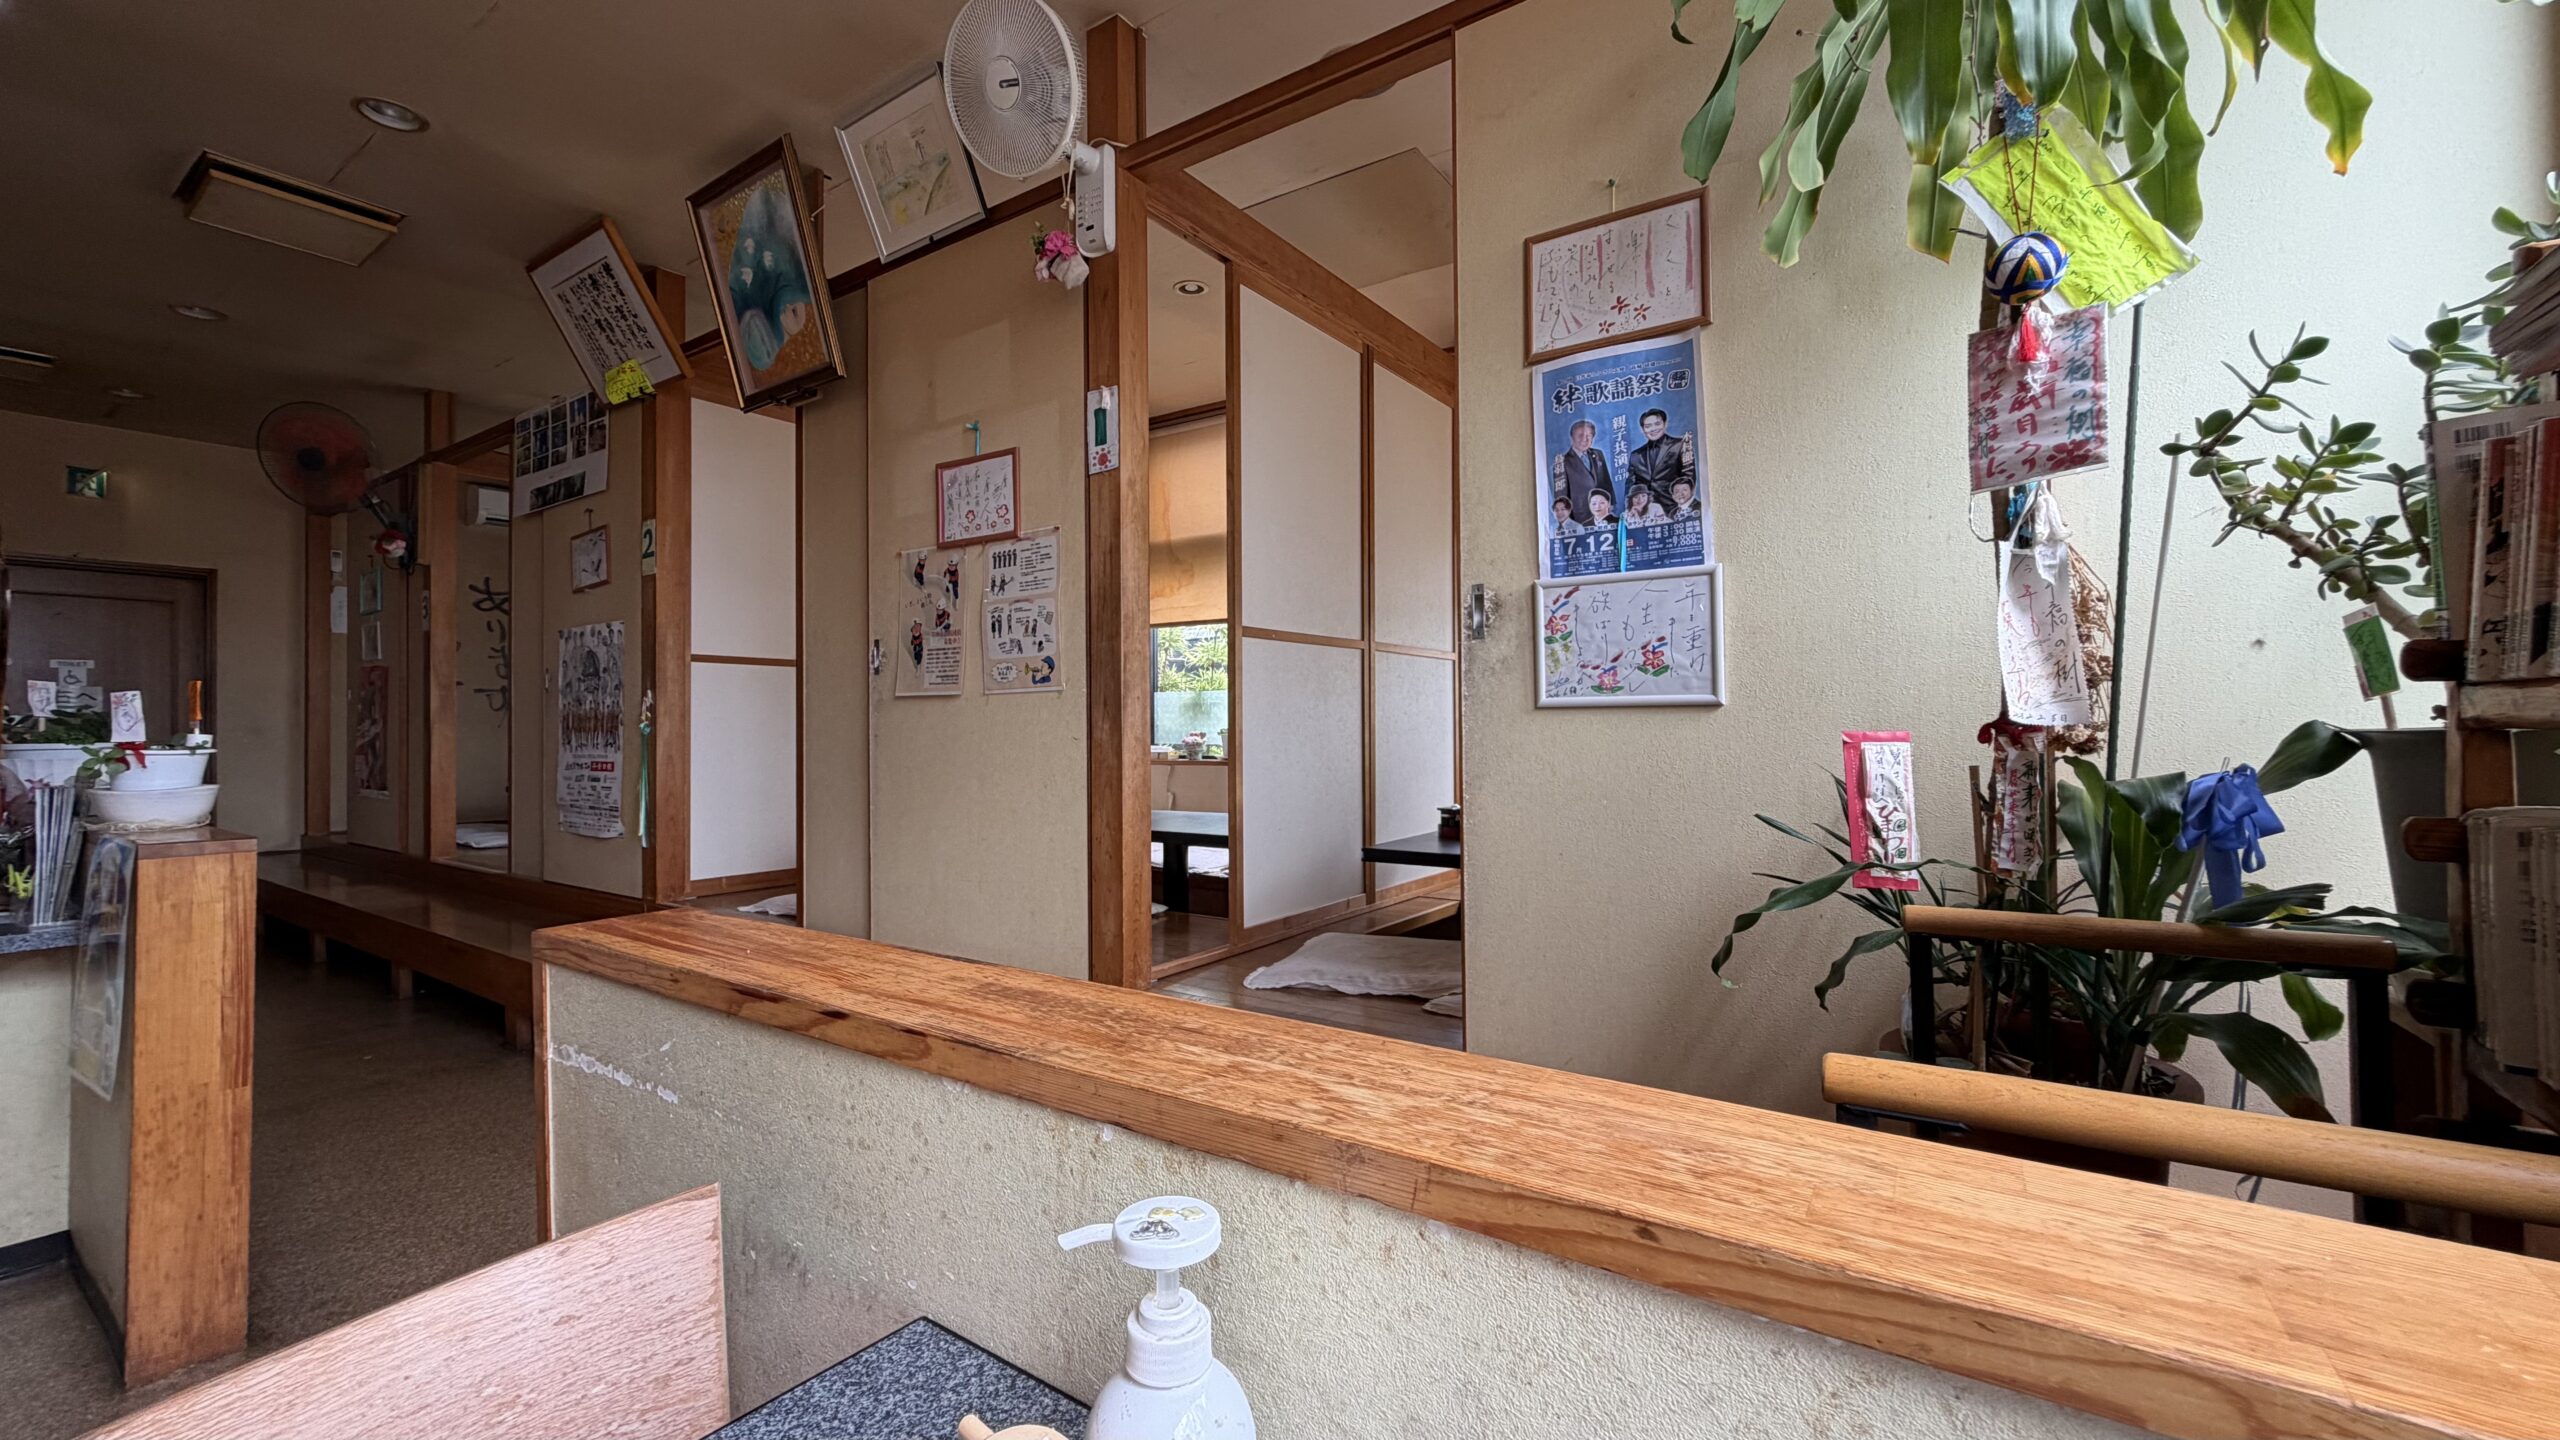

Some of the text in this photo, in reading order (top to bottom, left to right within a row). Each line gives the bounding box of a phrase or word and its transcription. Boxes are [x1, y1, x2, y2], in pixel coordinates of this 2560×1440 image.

[1551, 371, 1664, 413] 絆歌謡祭
[642, 529, 655, 559] 2
